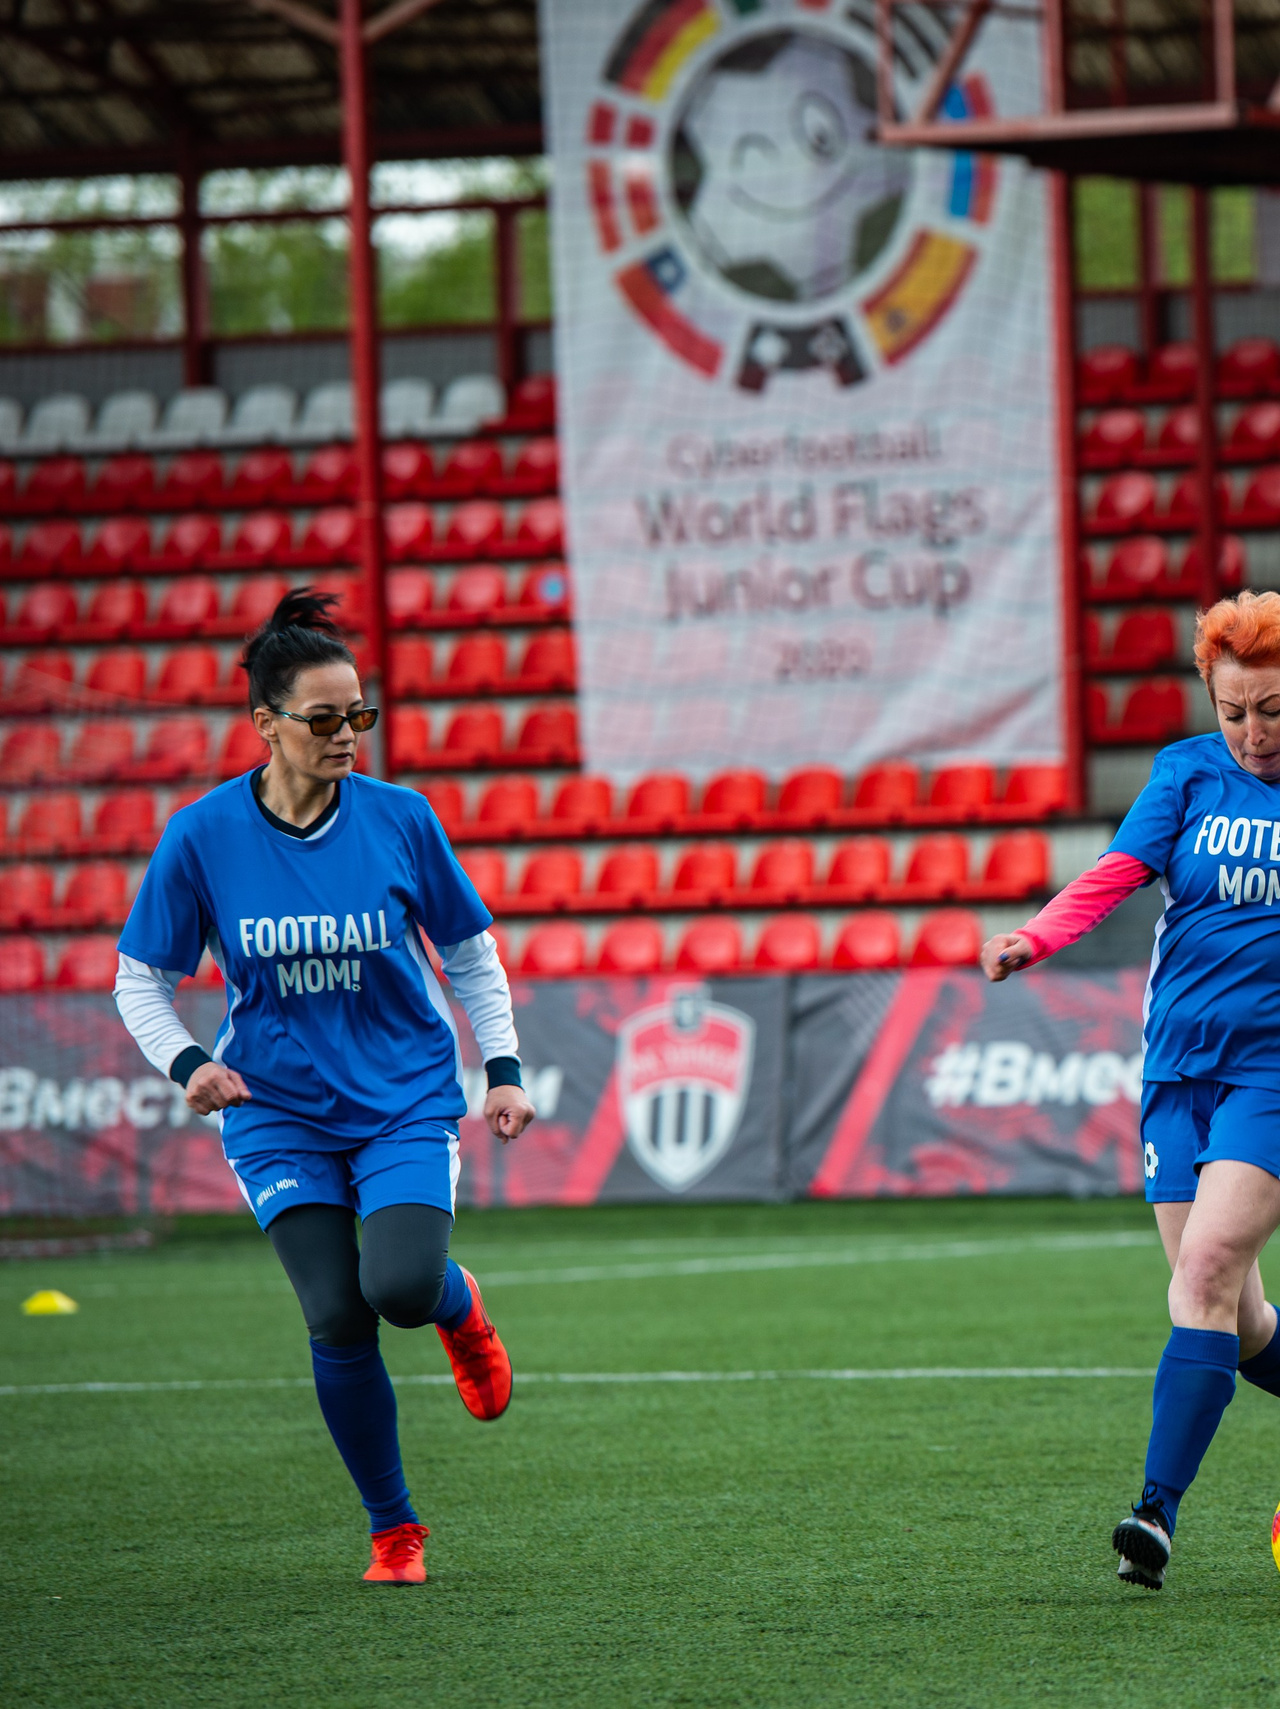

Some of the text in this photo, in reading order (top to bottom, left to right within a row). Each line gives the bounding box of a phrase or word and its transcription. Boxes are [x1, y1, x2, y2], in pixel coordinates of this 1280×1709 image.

[634, 480, 987, 551] World Flags
[664, 549, 972, 625] Junior Cup
[239, 909, 392, 958] FOOTBALL
[276, 958, 362, 998] MOM!
